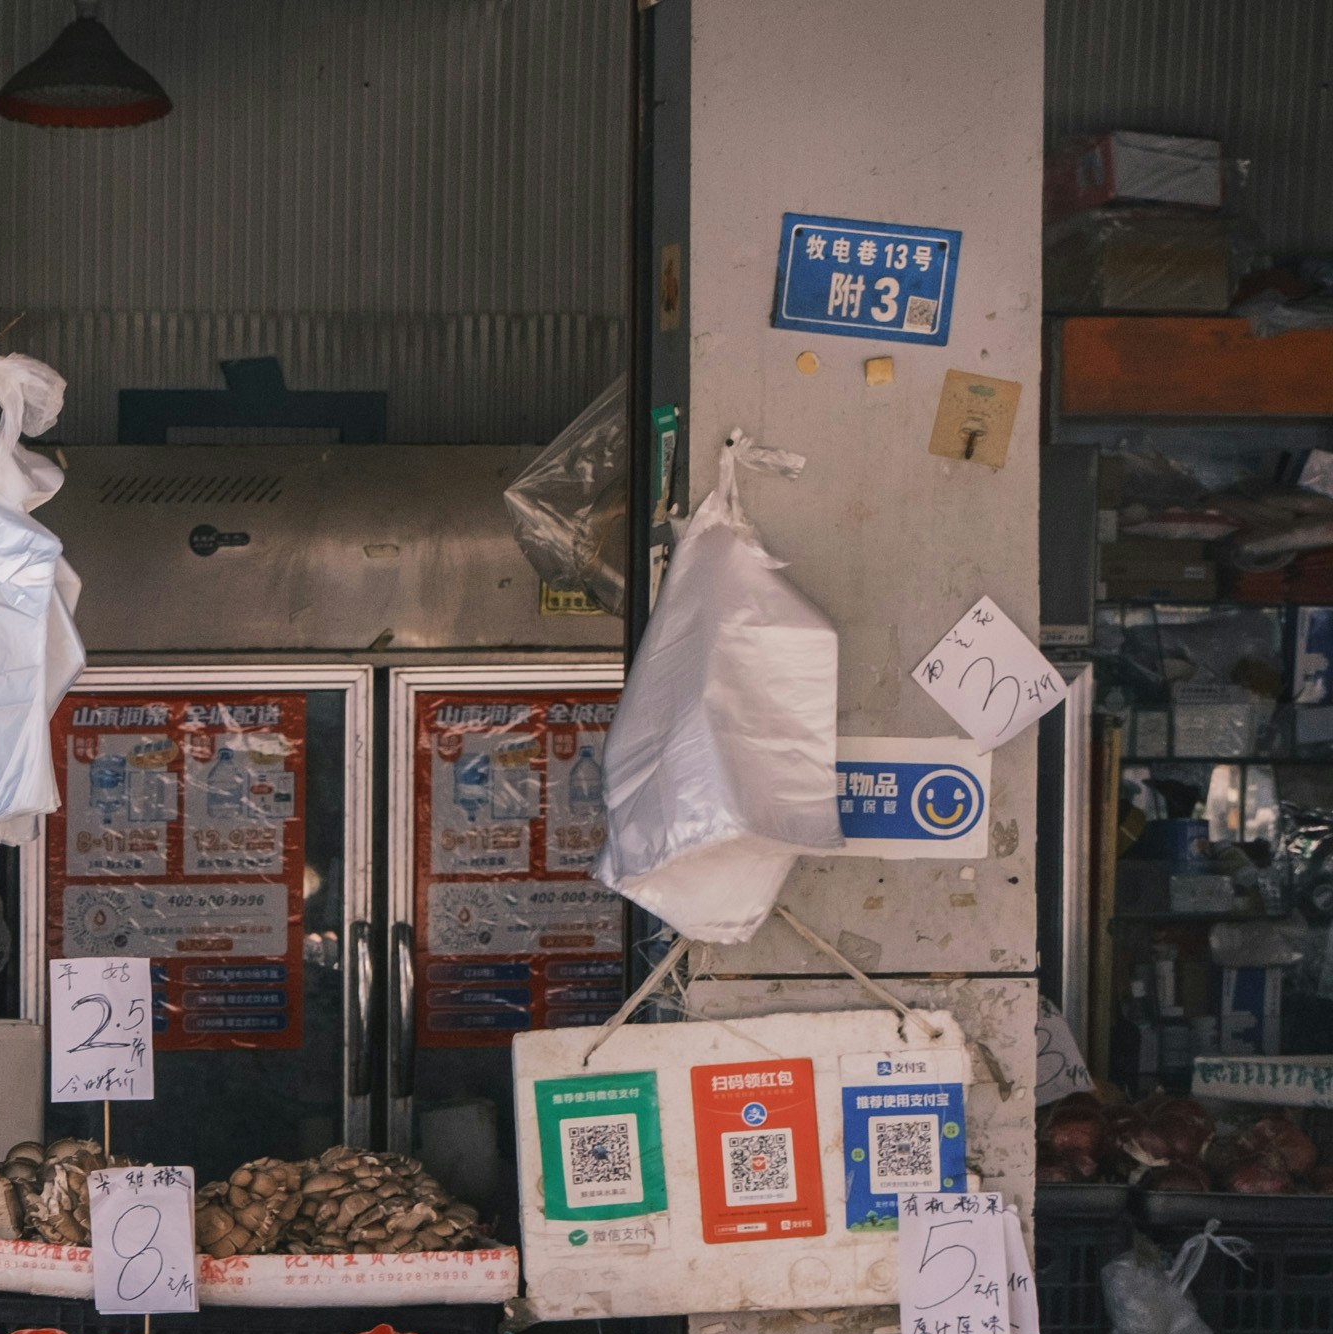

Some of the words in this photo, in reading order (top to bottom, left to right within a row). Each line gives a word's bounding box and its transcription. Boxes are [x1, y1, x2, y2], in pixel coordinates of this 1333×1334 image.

[805, 234, 933, 272] 牧电巷13号
[827, 272, 901, 322] 附3
[958, 656, 1020, 737] 3
[66, 993, 145, 1053] 2.5
[711, 1070, 794, 1092] 扫码领红包
[894, 1061, 927, 1074] 支付宝
[856, 1093, 950, 1109] 推荐使用支付宝
[112, 1204, 163, 1301] 8
[916, 1220, 976, 1310] 5
